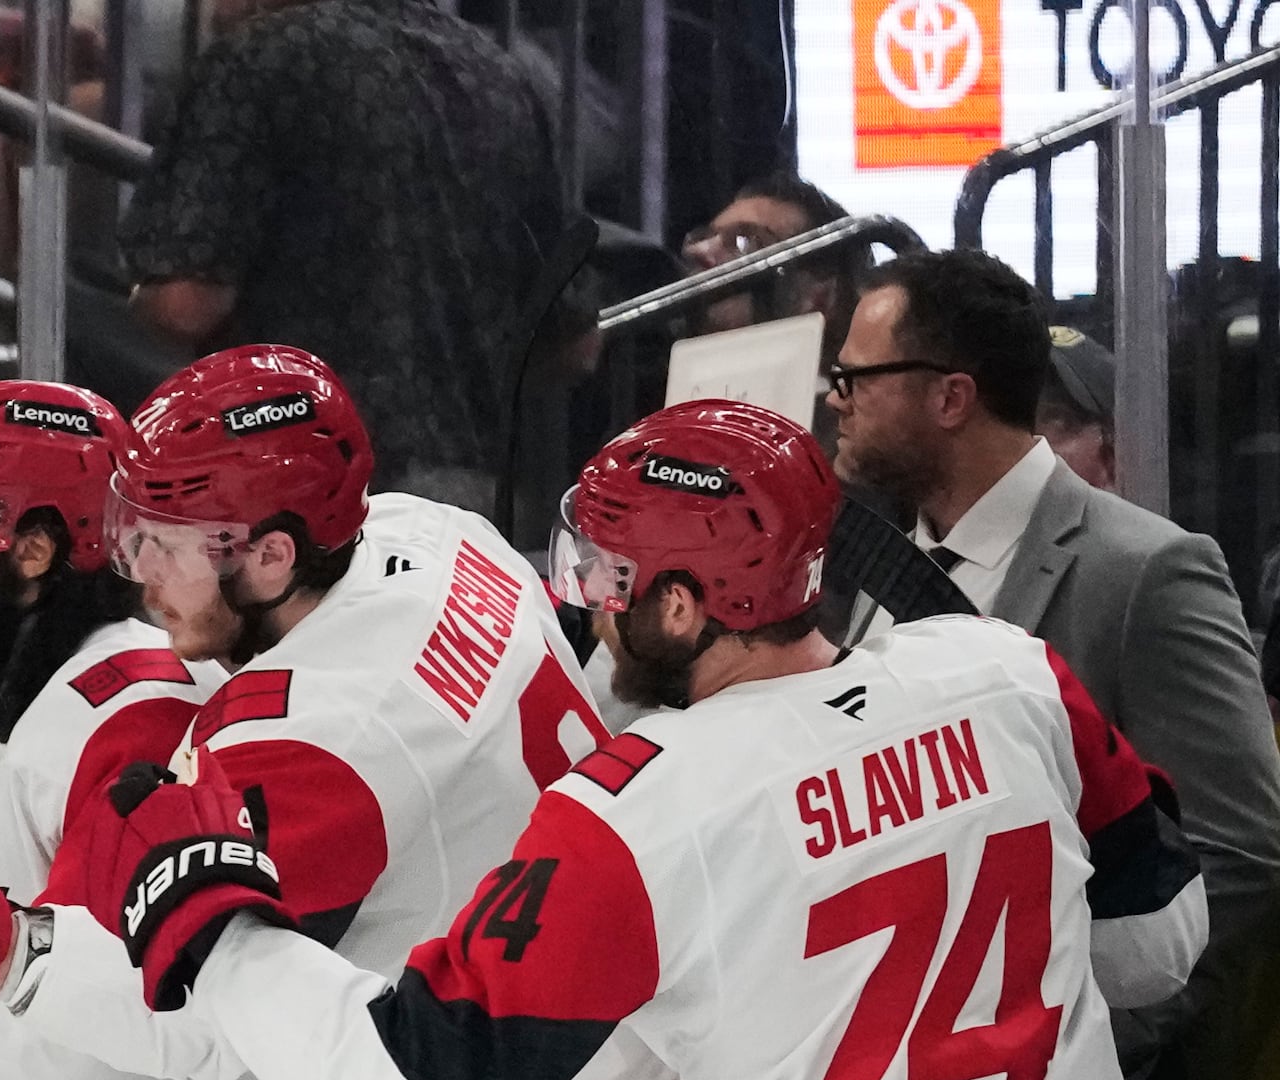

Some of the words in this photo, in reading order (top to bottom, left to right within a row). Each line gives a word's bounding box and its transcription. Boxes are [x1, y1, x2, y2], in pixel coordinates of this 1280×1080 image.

[11, 401, 88, 430] Lenovo
[225, 398, 308, 431] Lenovo
[646, 459, 723, 490] Lenovo
[412, 539, 524, 722] NIKISHIN
[794, 717, 990, 861] SLAVIN
[460, 857, 560, 964] 74
